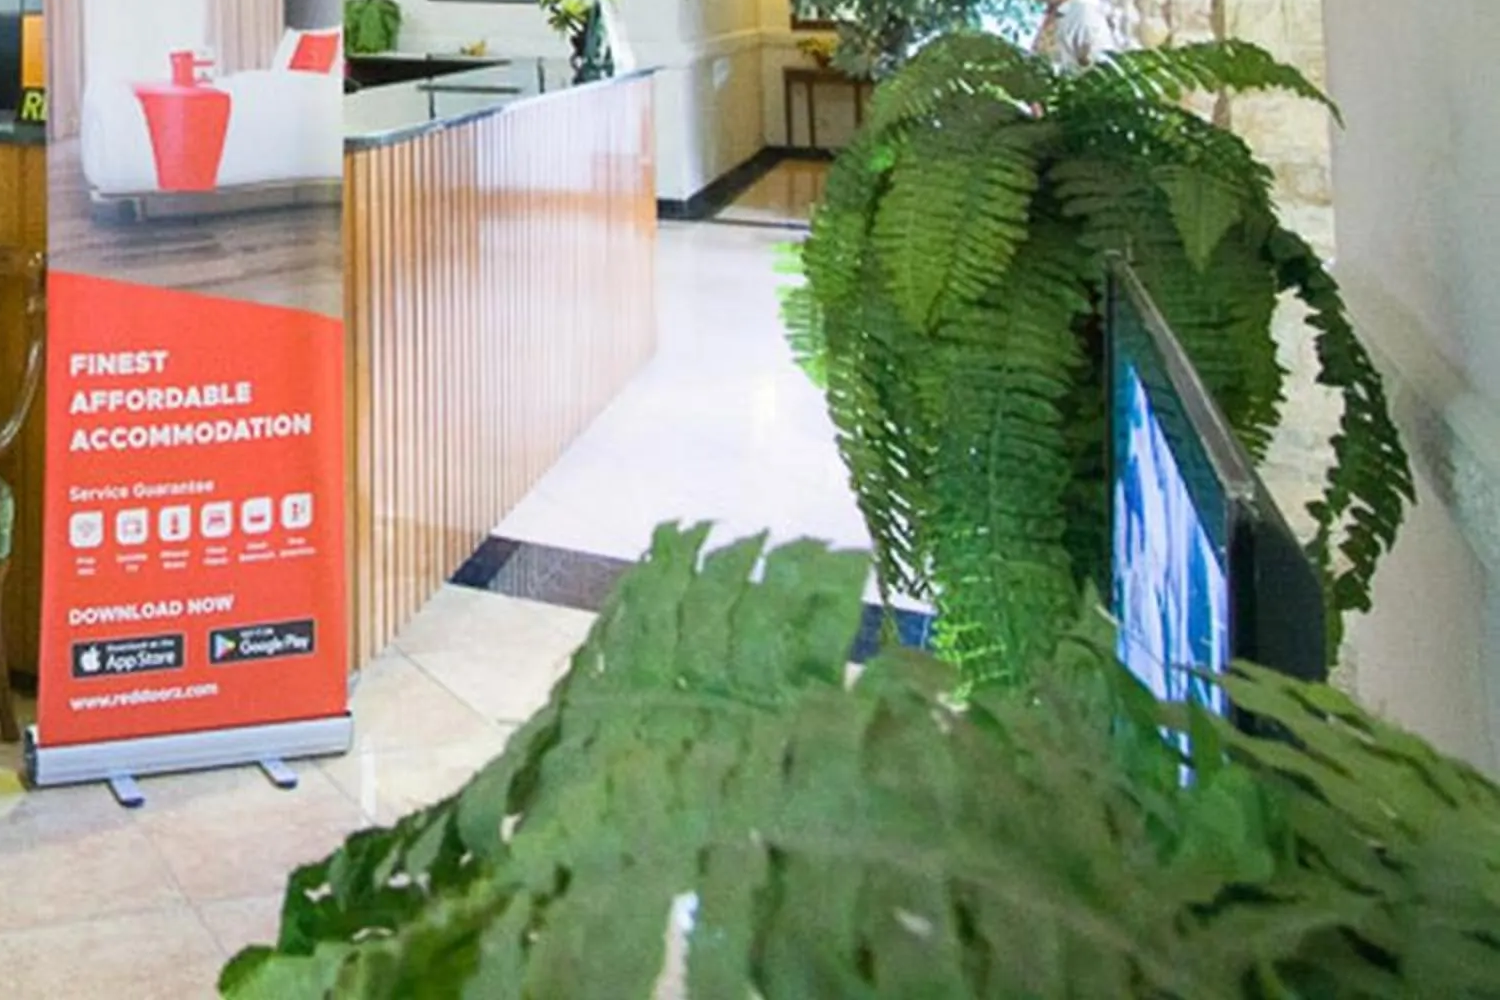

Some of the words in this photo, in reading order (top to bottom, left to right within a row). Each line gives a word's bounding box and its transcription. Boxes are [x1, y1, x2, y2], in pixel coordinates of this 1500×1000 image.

[69, 351, 168, 376] FINEST
[70, 381, 253, 414] AFFORDABLE
[69, 413, 312, 452] ACCOMMODATION
[69, 483, 128, 502] Service
[132, 479, 215, 498] Guarantee
[68, 599, 182, 626] DOWNLOAD
[187, 594, 235, 615] NOW
[105, 653, 137, 672] App
[137, 649, 175, 668] Store
[69, 682, 219, 712] www.reddoorz.com
